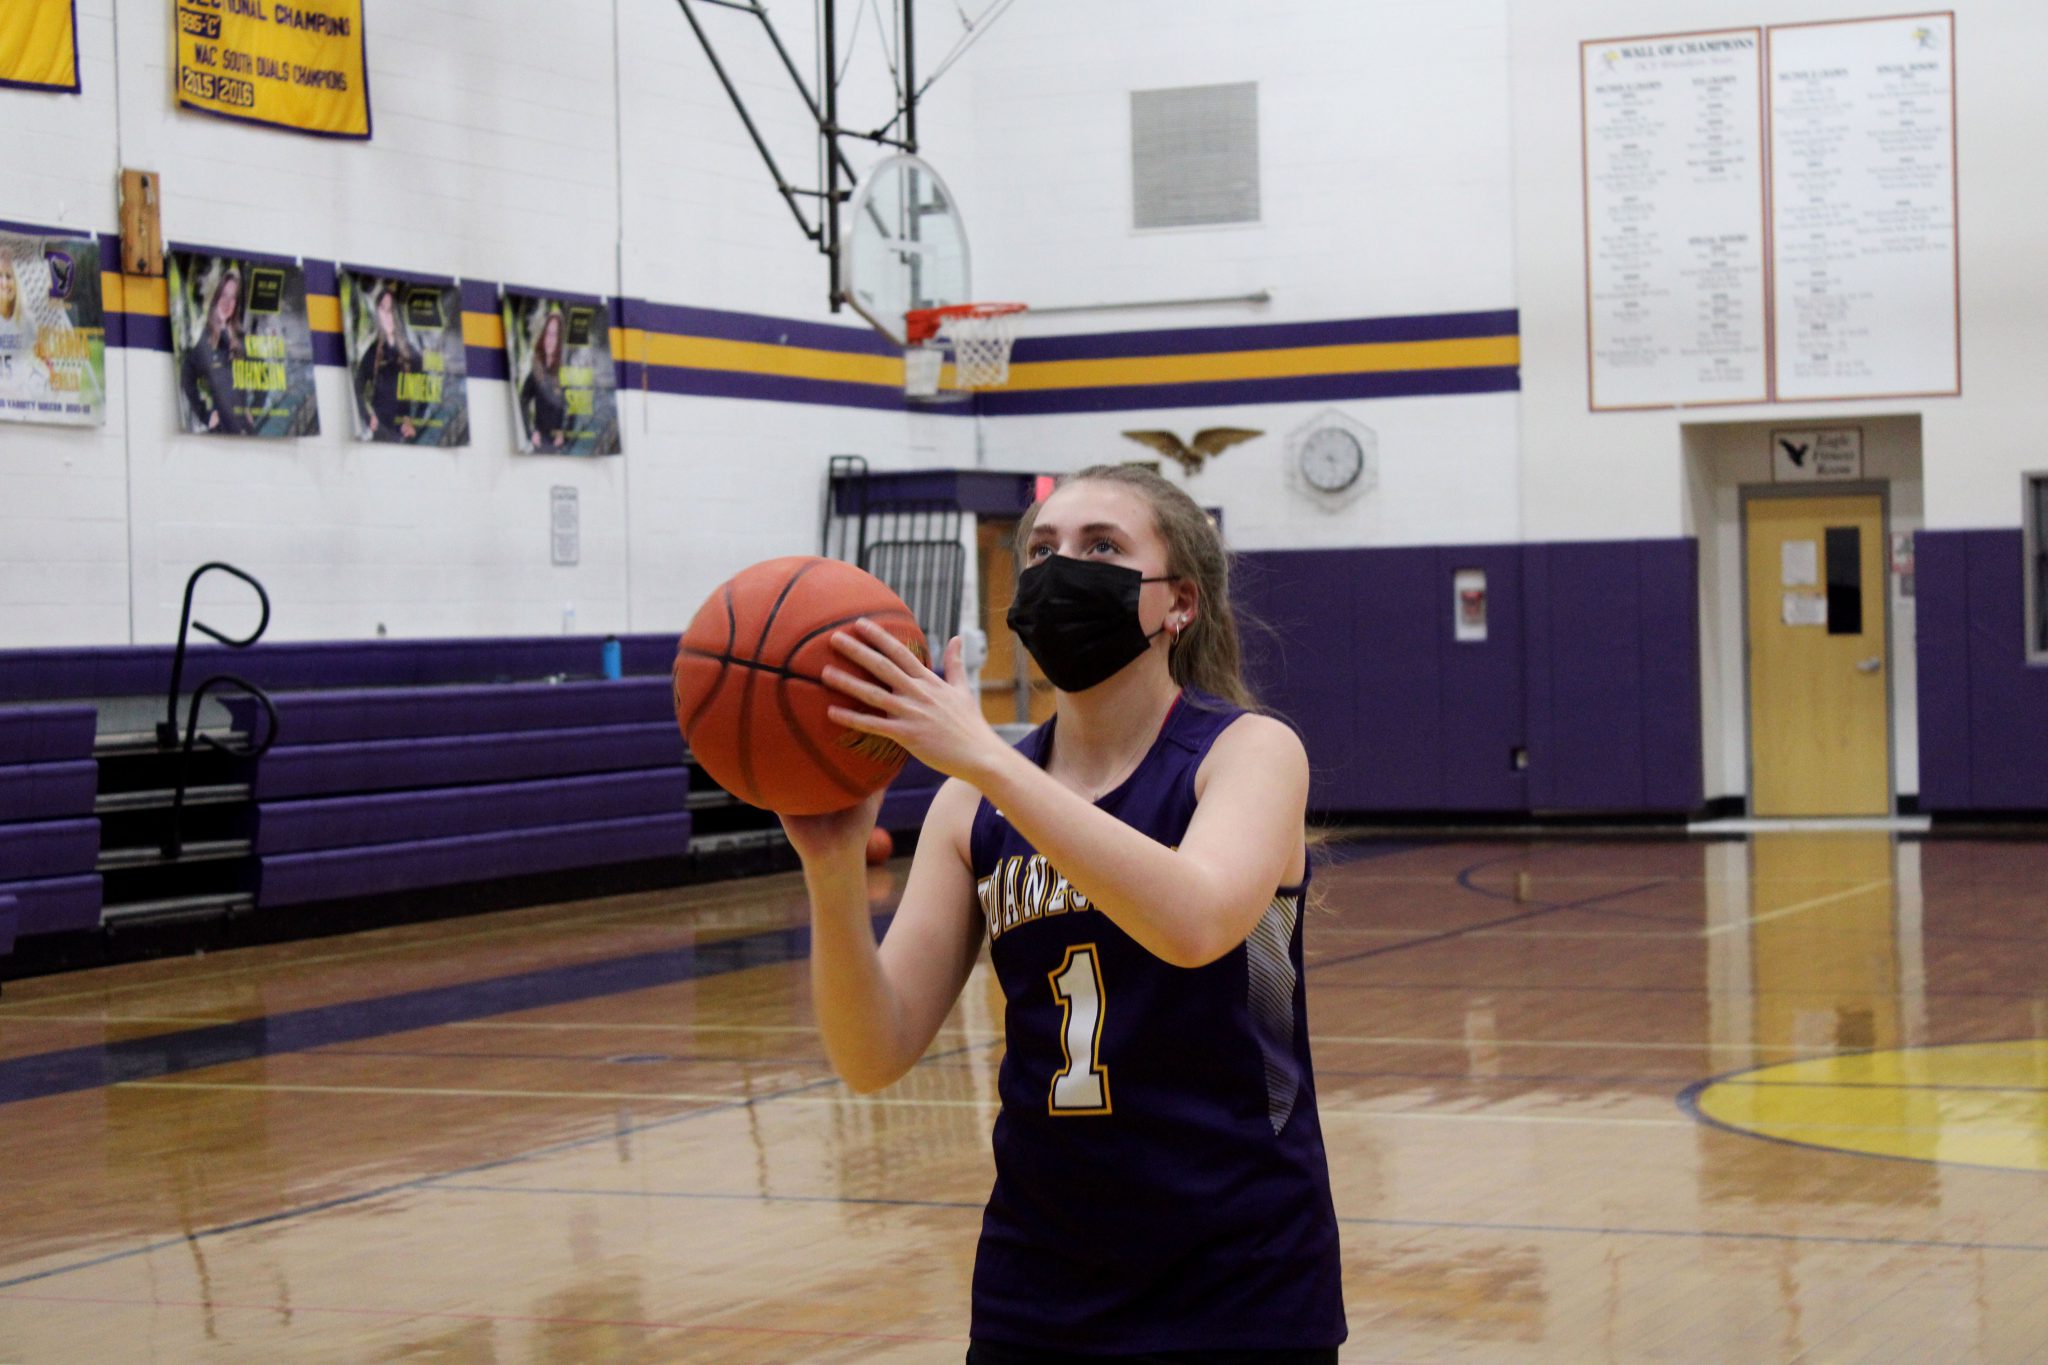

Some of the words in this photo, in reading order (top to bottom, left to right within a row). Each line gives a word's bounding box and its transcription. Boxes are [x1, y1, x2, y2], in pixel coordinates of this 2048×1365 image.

[218, 77, 253, 107] 2016
[223, 48, 253, 75] SOUTH
[256, 57, 290, 82] DUALS
[292, 64, 348, 92] CHAMPIONS
[1048, 942, 1112, 1117] 1
